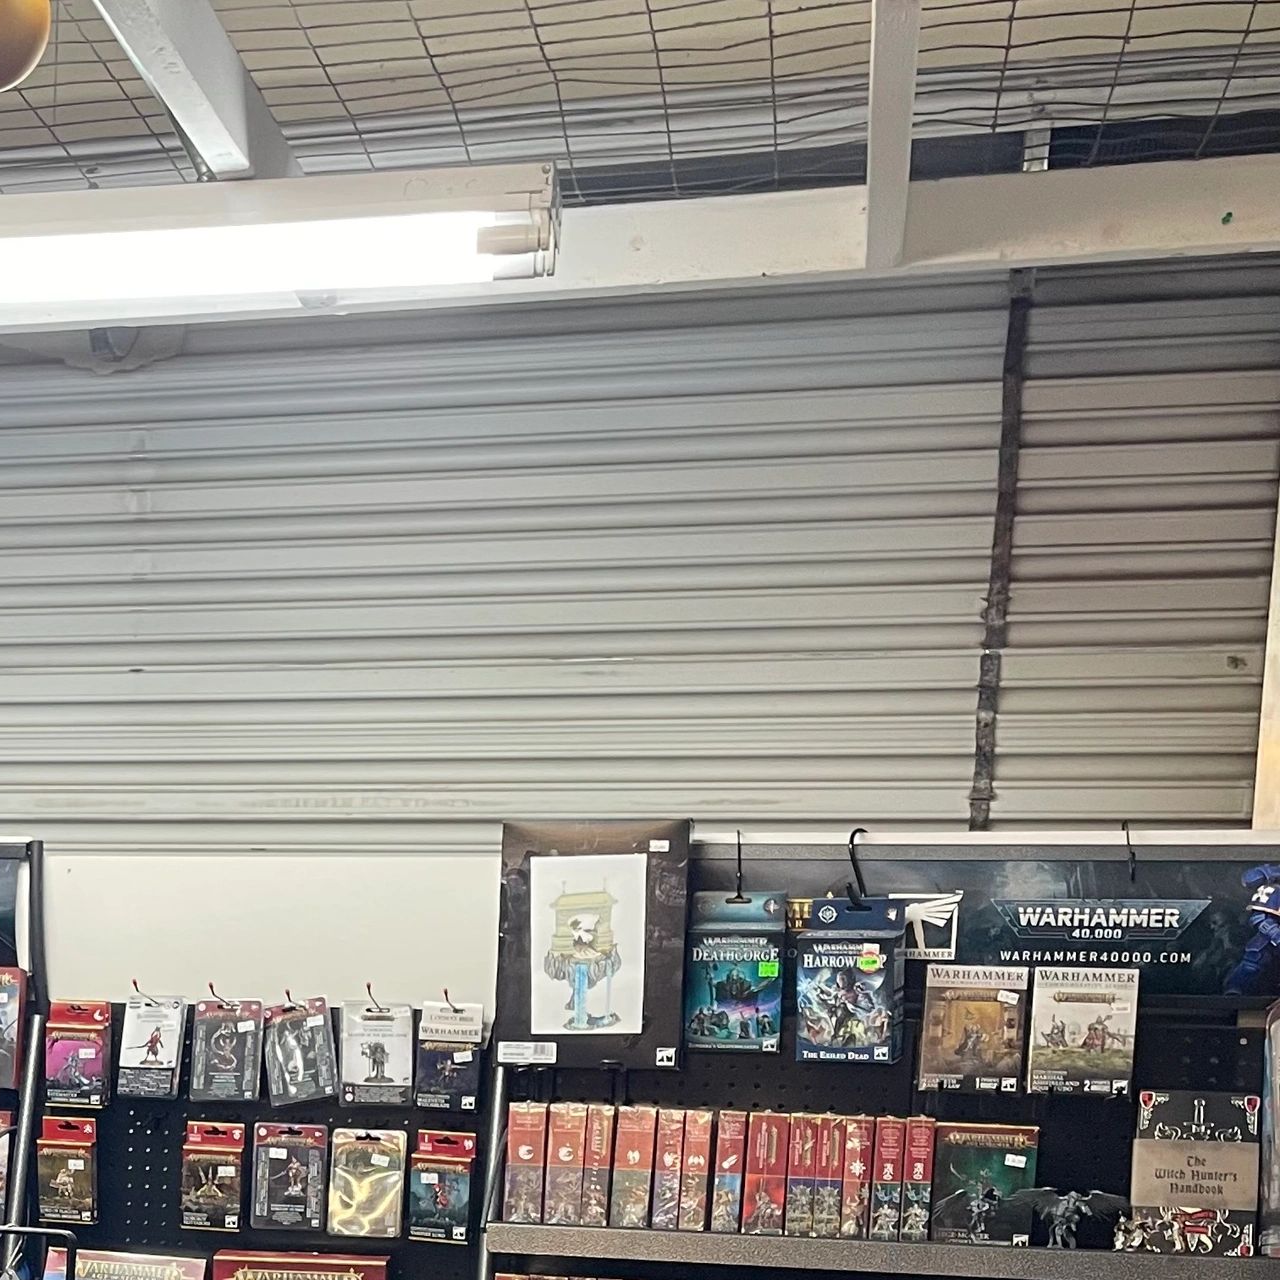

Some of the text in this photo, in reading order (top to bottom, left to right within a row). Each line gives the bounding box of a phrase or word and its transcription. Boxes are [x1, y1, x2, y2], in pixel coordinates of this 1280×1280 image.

[1017, 908, 1181, 928] WARHAMMER
[1071, 928, 1122, 939] 40,000
[692, 947, 780, 962] DEATHGORGE
[999, 951, 1192, 963] WARHAMMER40000.COM
[930, 968, 1025, 982] WARHAMMER
[1039, 970, 1136, 983] WARHAMMER
[421, 1027, 480, 1037] WARHAMMER
[802, 1050, 870, 1060] THE EXILED DEAD
[1187, 1155, 1207, 1167] The
[1154, 1168, 1237, 1182] Witch Hunter's
[1170, 1182, 1224, 1195] Handbook
